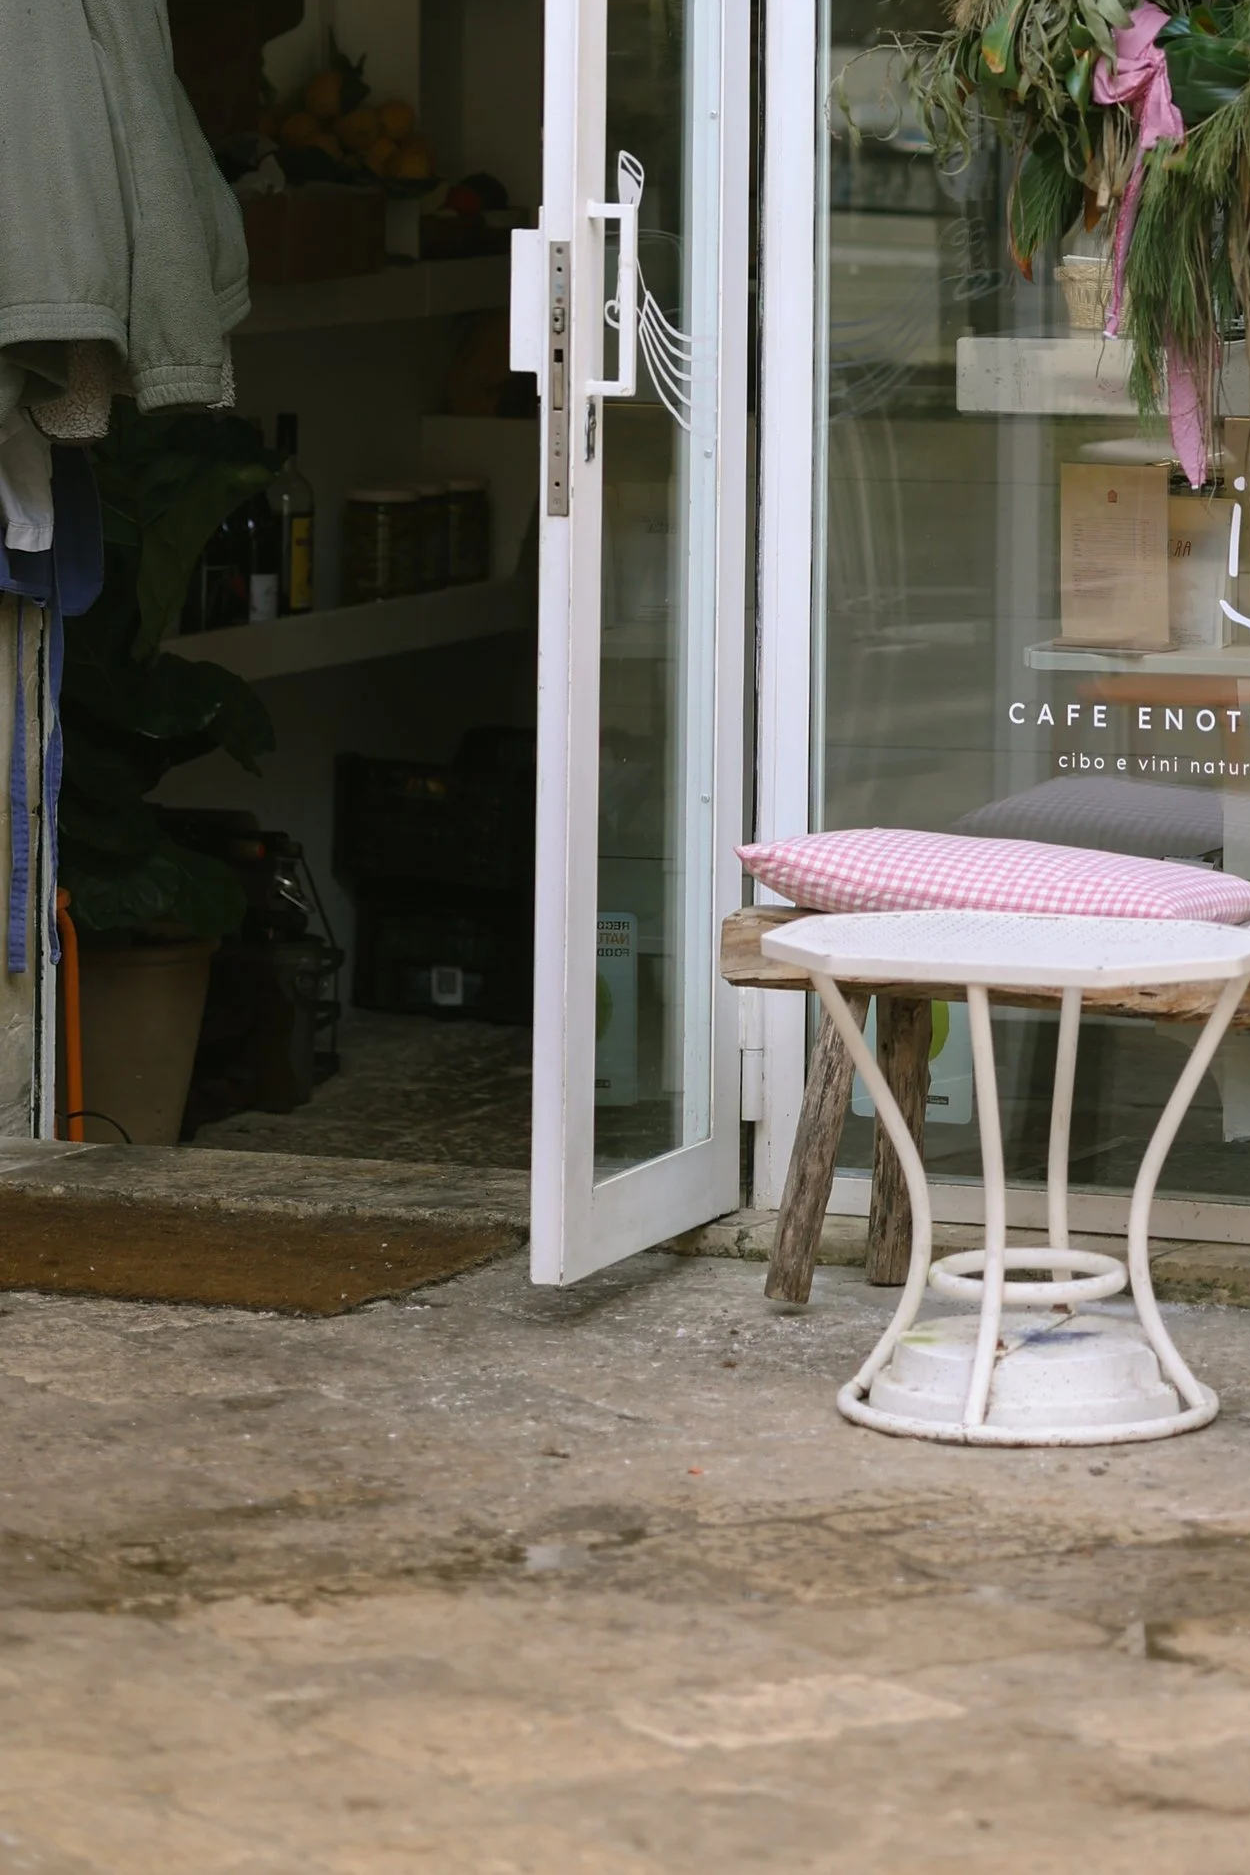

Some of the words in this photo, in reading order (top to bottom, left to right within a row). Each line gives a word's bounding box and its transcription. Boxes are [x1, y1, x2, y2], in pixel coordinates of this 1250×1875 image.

[1008, 702, 1107, 728] CAFE
[1058, 752, 1105, 770] cibo
[1116, 757, 1127, 771] e
[1138, 755, 1179, 773] vini
